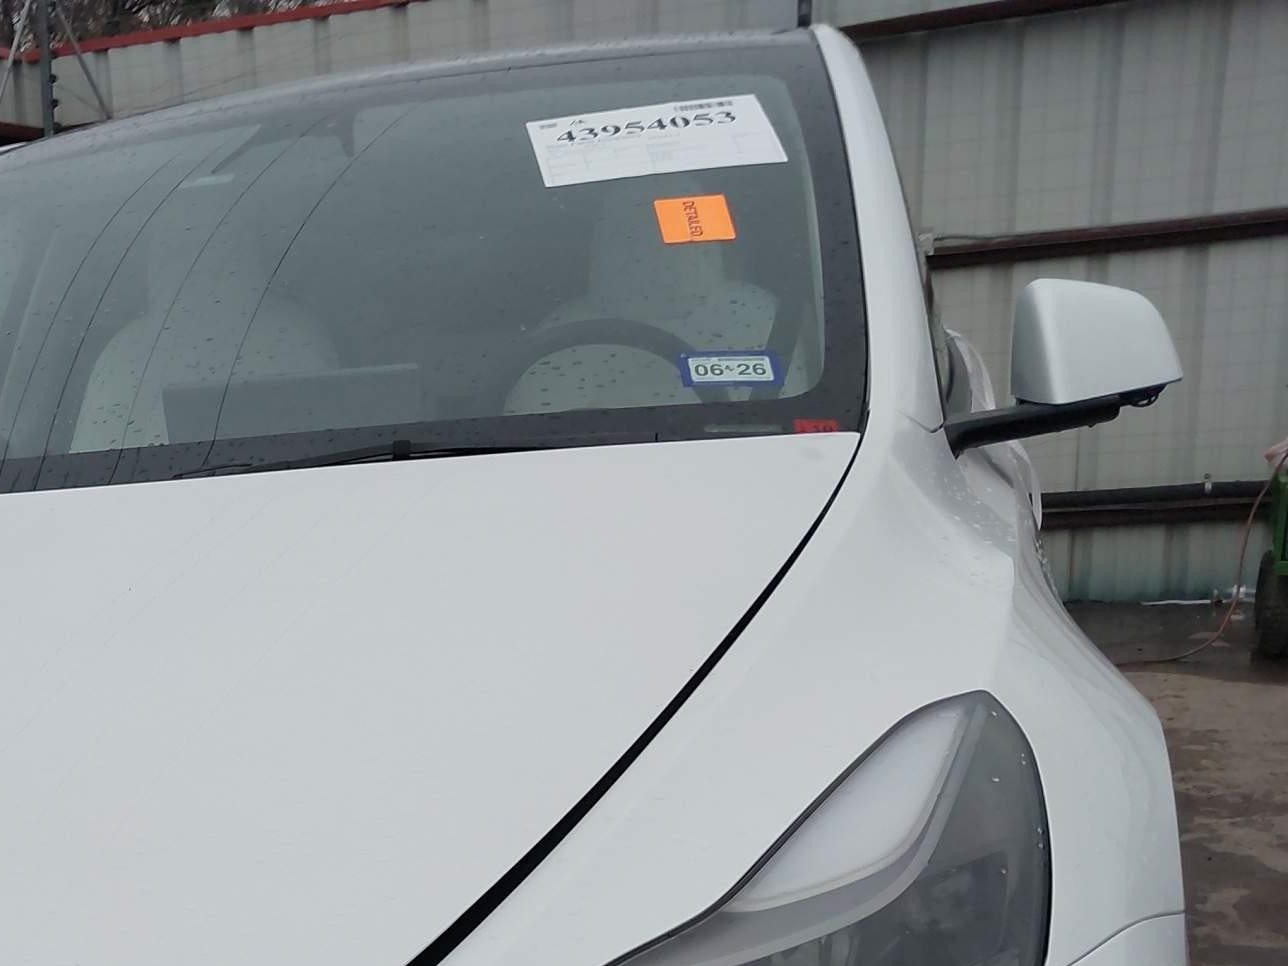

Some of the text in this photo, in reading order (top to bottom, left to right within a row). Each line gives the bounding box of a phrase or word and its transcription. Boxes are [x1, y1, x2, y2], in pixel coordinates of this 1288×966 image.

[556, 111, 737, 143] 43954053
[682, 200, 704, 237] DETAILED
[694, 363, 767, 376] 06 26
